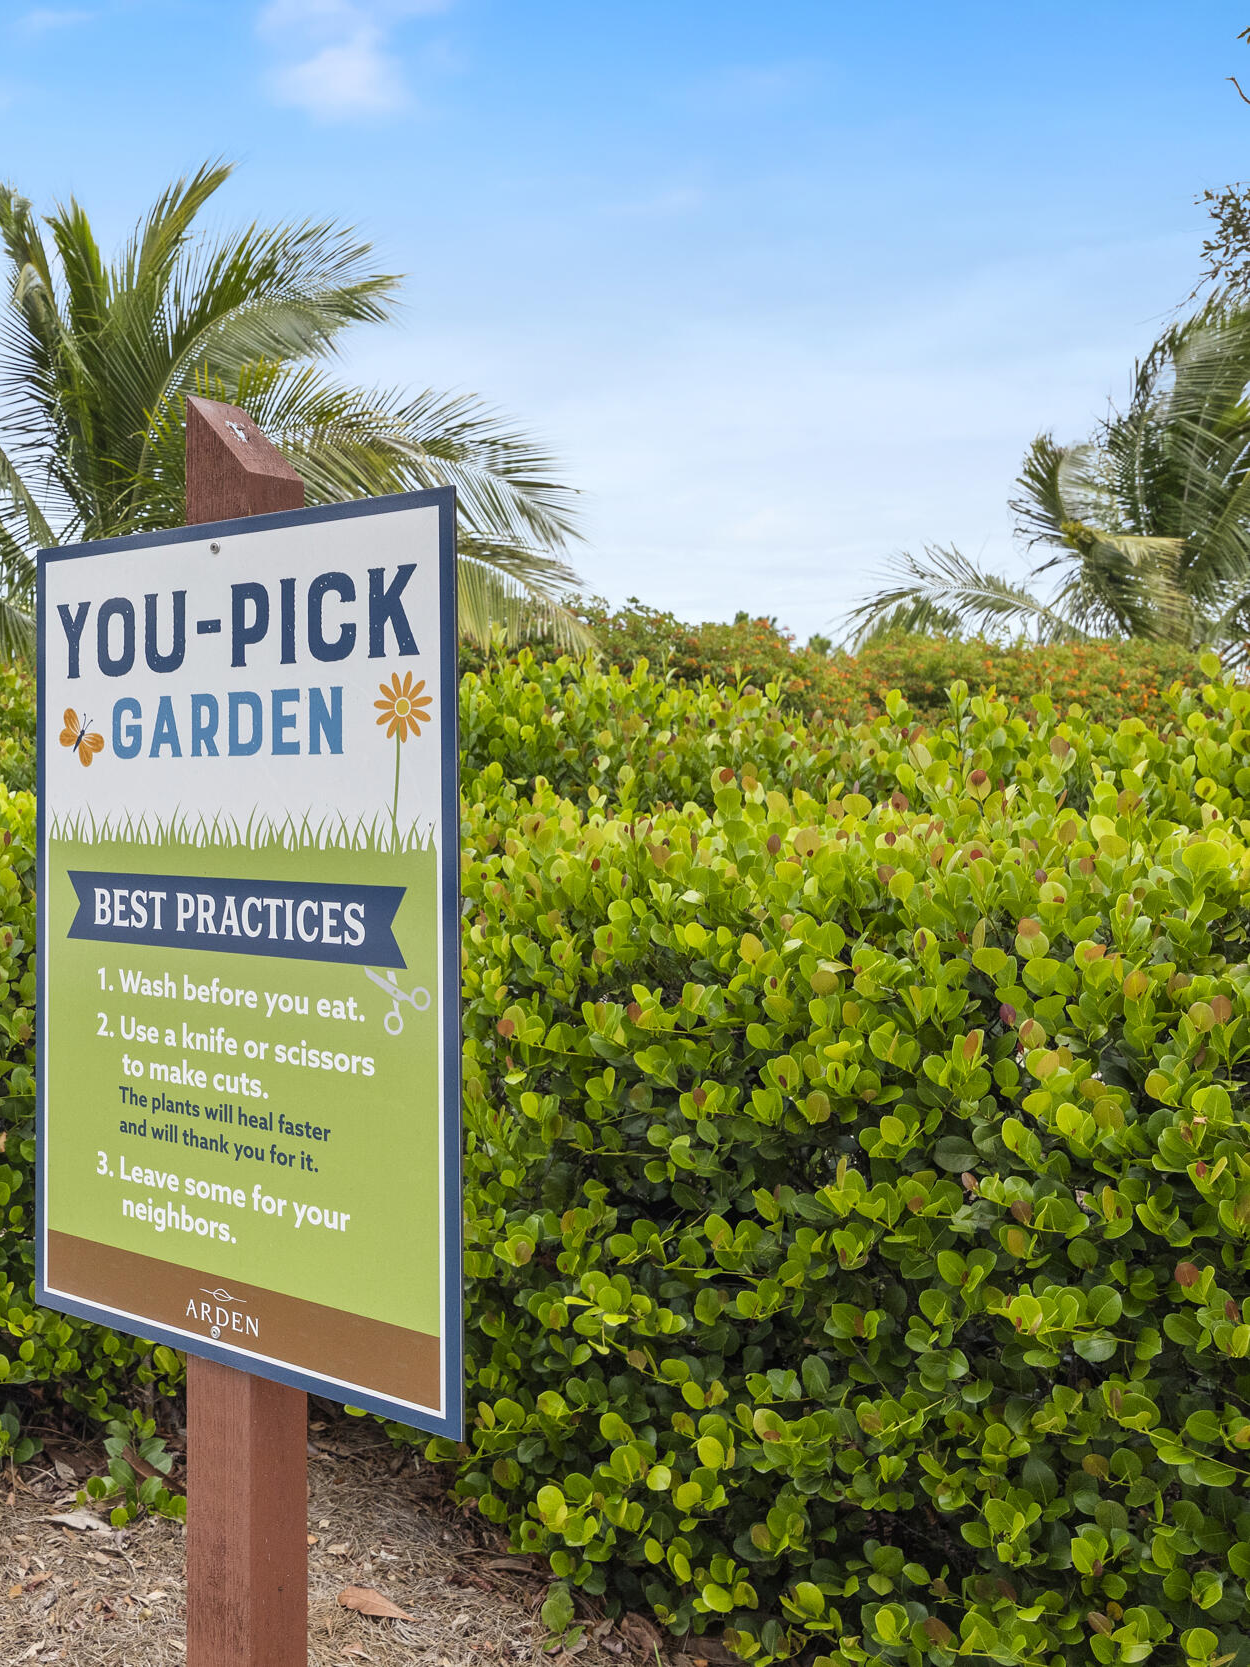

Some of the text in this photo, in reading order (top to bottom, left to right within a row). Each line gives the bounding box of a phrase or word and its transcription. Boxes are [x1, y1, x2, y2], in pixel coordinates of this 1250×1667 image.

[57, 563, 420, 679] YOU-PICK
[112, 686, 344, 759] GARDEN
[93, 887, 366, 946] BEST PRACTICES
[97, 967, 366, 1022] 1. Wash before you eat.
[96, 1012, 375, 1077] 2. Use a knife or scissors
[122, 1053, 269, 1100] to make cuts.
[119, 1085, 331, 1143] The plants will heal faster
[119, 1119, 319, 1173] and will thank you for it.
[96, 1150, 351, 1232] 3. Leave some for your
[122, 1197, 237, 1244] neighbors.
[185, 1298, 260, 1338] ARDEN
